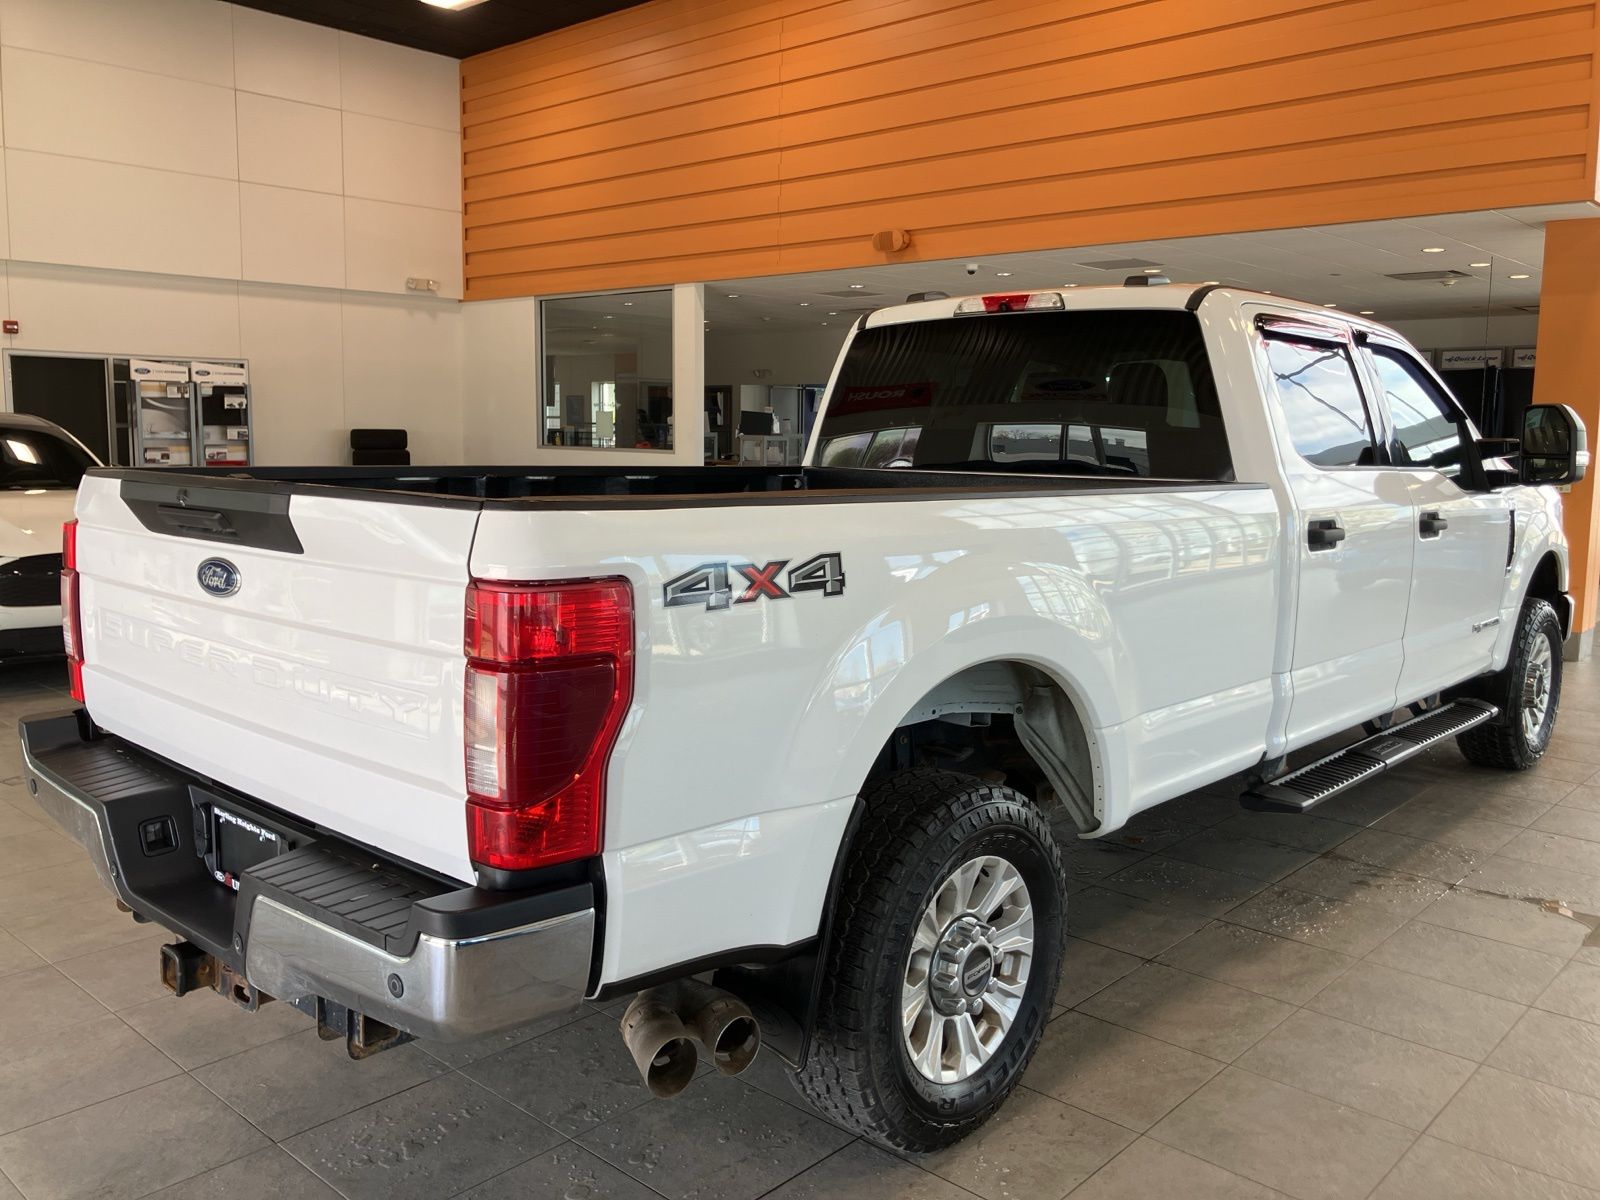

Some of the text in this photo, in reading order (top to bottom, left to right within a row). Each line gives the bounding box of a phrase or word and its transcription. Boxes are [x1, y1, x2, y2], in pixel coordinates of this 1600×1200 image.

[201, 564, 232, 590] Ford
[103, 614, 428, 724] SUPER DUTY
